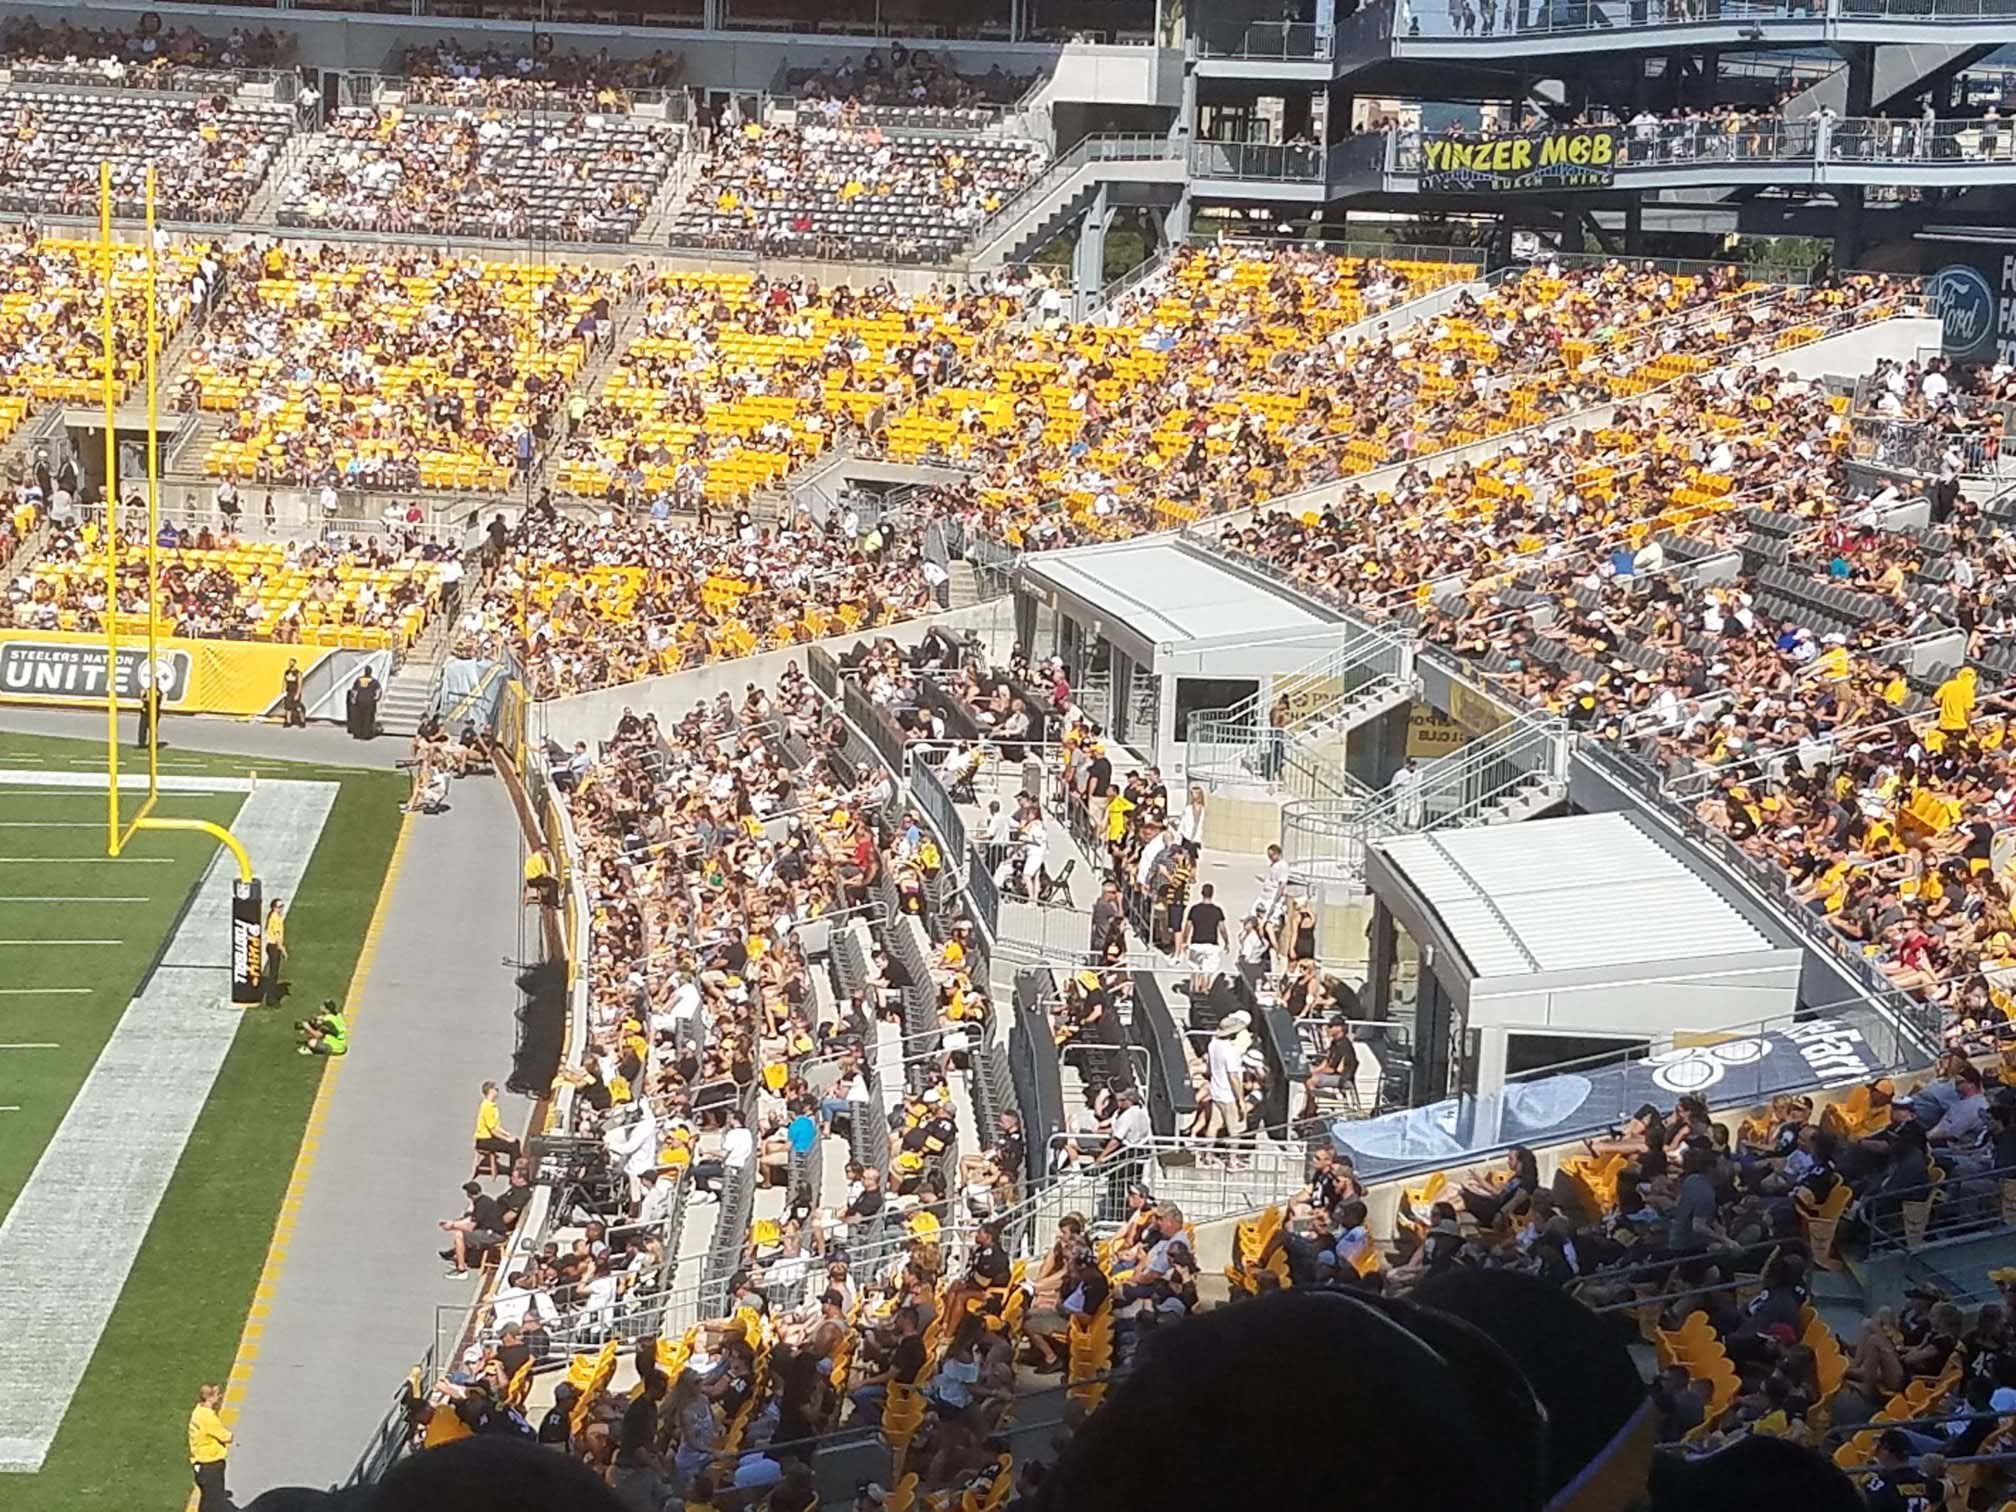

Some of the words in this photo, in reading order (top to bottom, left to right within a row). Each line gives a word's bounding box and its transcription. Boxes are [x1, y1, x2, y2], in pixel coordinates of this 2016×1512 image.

[1424, 140, 1532, 170] YINZER
[1540, 134, 1612, 165] MOB
[1941, 279, 1980, 339] Ford
[5, 661, 132, 693] UNITE
[10, 650, 79, 663] STEELERS
[83, 654, 134, 665] NATON
[234, 919, 250, 984] FOOTBALL
[247, 935, 261, 977] PLAY
